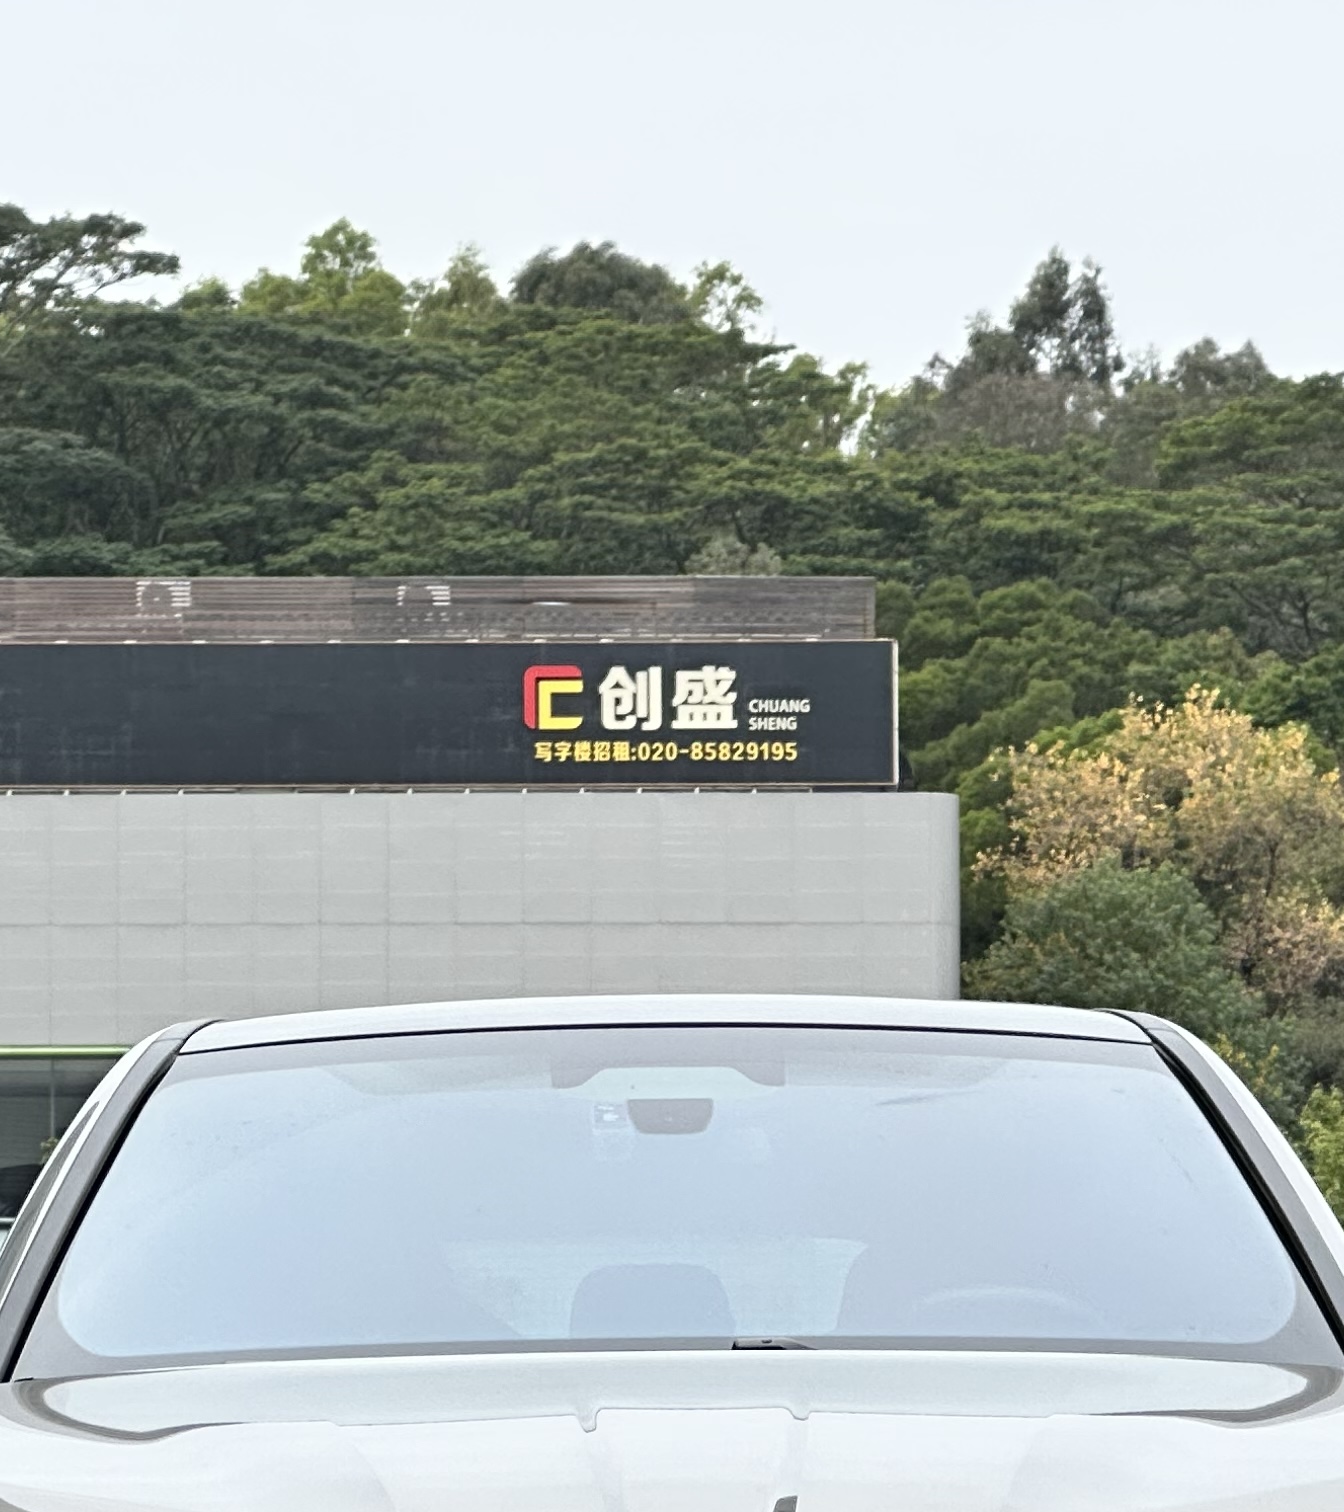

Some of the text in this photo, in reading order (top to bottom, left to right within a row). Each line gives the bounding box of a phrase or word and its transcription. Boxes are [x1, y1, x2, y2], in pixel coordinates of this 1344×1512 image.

[598, 664, 739, 731] 创盛
[747, 698, 811, 714] CHUANG
[747, 716, 798, 731] SHENG
